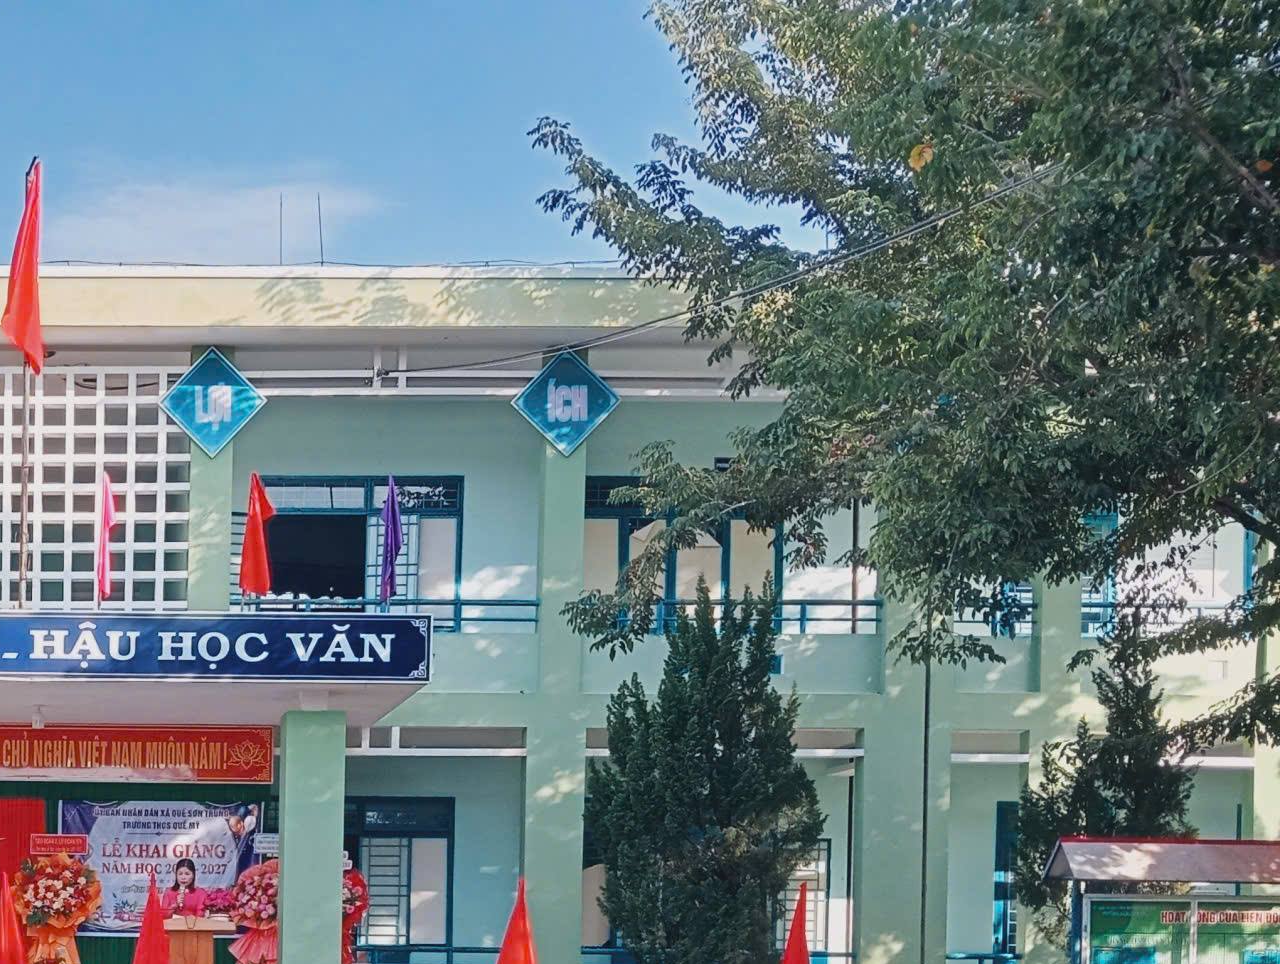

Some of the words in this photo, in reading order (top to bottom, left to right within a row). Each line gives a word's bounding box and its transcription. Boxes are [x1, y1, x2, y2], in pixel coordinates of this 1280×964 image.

[194, 382, 232, 431] LỢI
[547, 378, 588, 422] ÍCH
[29, 621, 141, 669] HẬU
[157, 631, 270, 670] HỌC
[286, 624, 396, 662] VĂN
[2, 731, 29, 767] CHỦ
[33, 735, 77, 768] NGHĨA
[111, 741, 143, 769] NAM
[145, 736, 187, 769] MUÔN
[106, 808, 120, 817] BAN
[122, 808, 143, 817] NHÂN
[144, 808, 159, 817] DÂN
[160, 808, 171, 817] XÃ
[172, 807, 186, 818] QUẾ
[187, 808, 203, 817] SƠN
[205, 809, 230, 818] TRUNG
[122, 819, 152, 830] TRƯỜNG
[153, 821, 171, 830] THCS
[172, 819, 186, 830] QUẾ
[102, 837, 122, 858] LỄ
[125, 843, 167, 858] KHAI
[173, 841, 226, 859] GIẢNG
[102, 860, 131, 874] NĂM
[135, 863, 162, 876] HỌC
[200, 863, 227, 875] 2027
